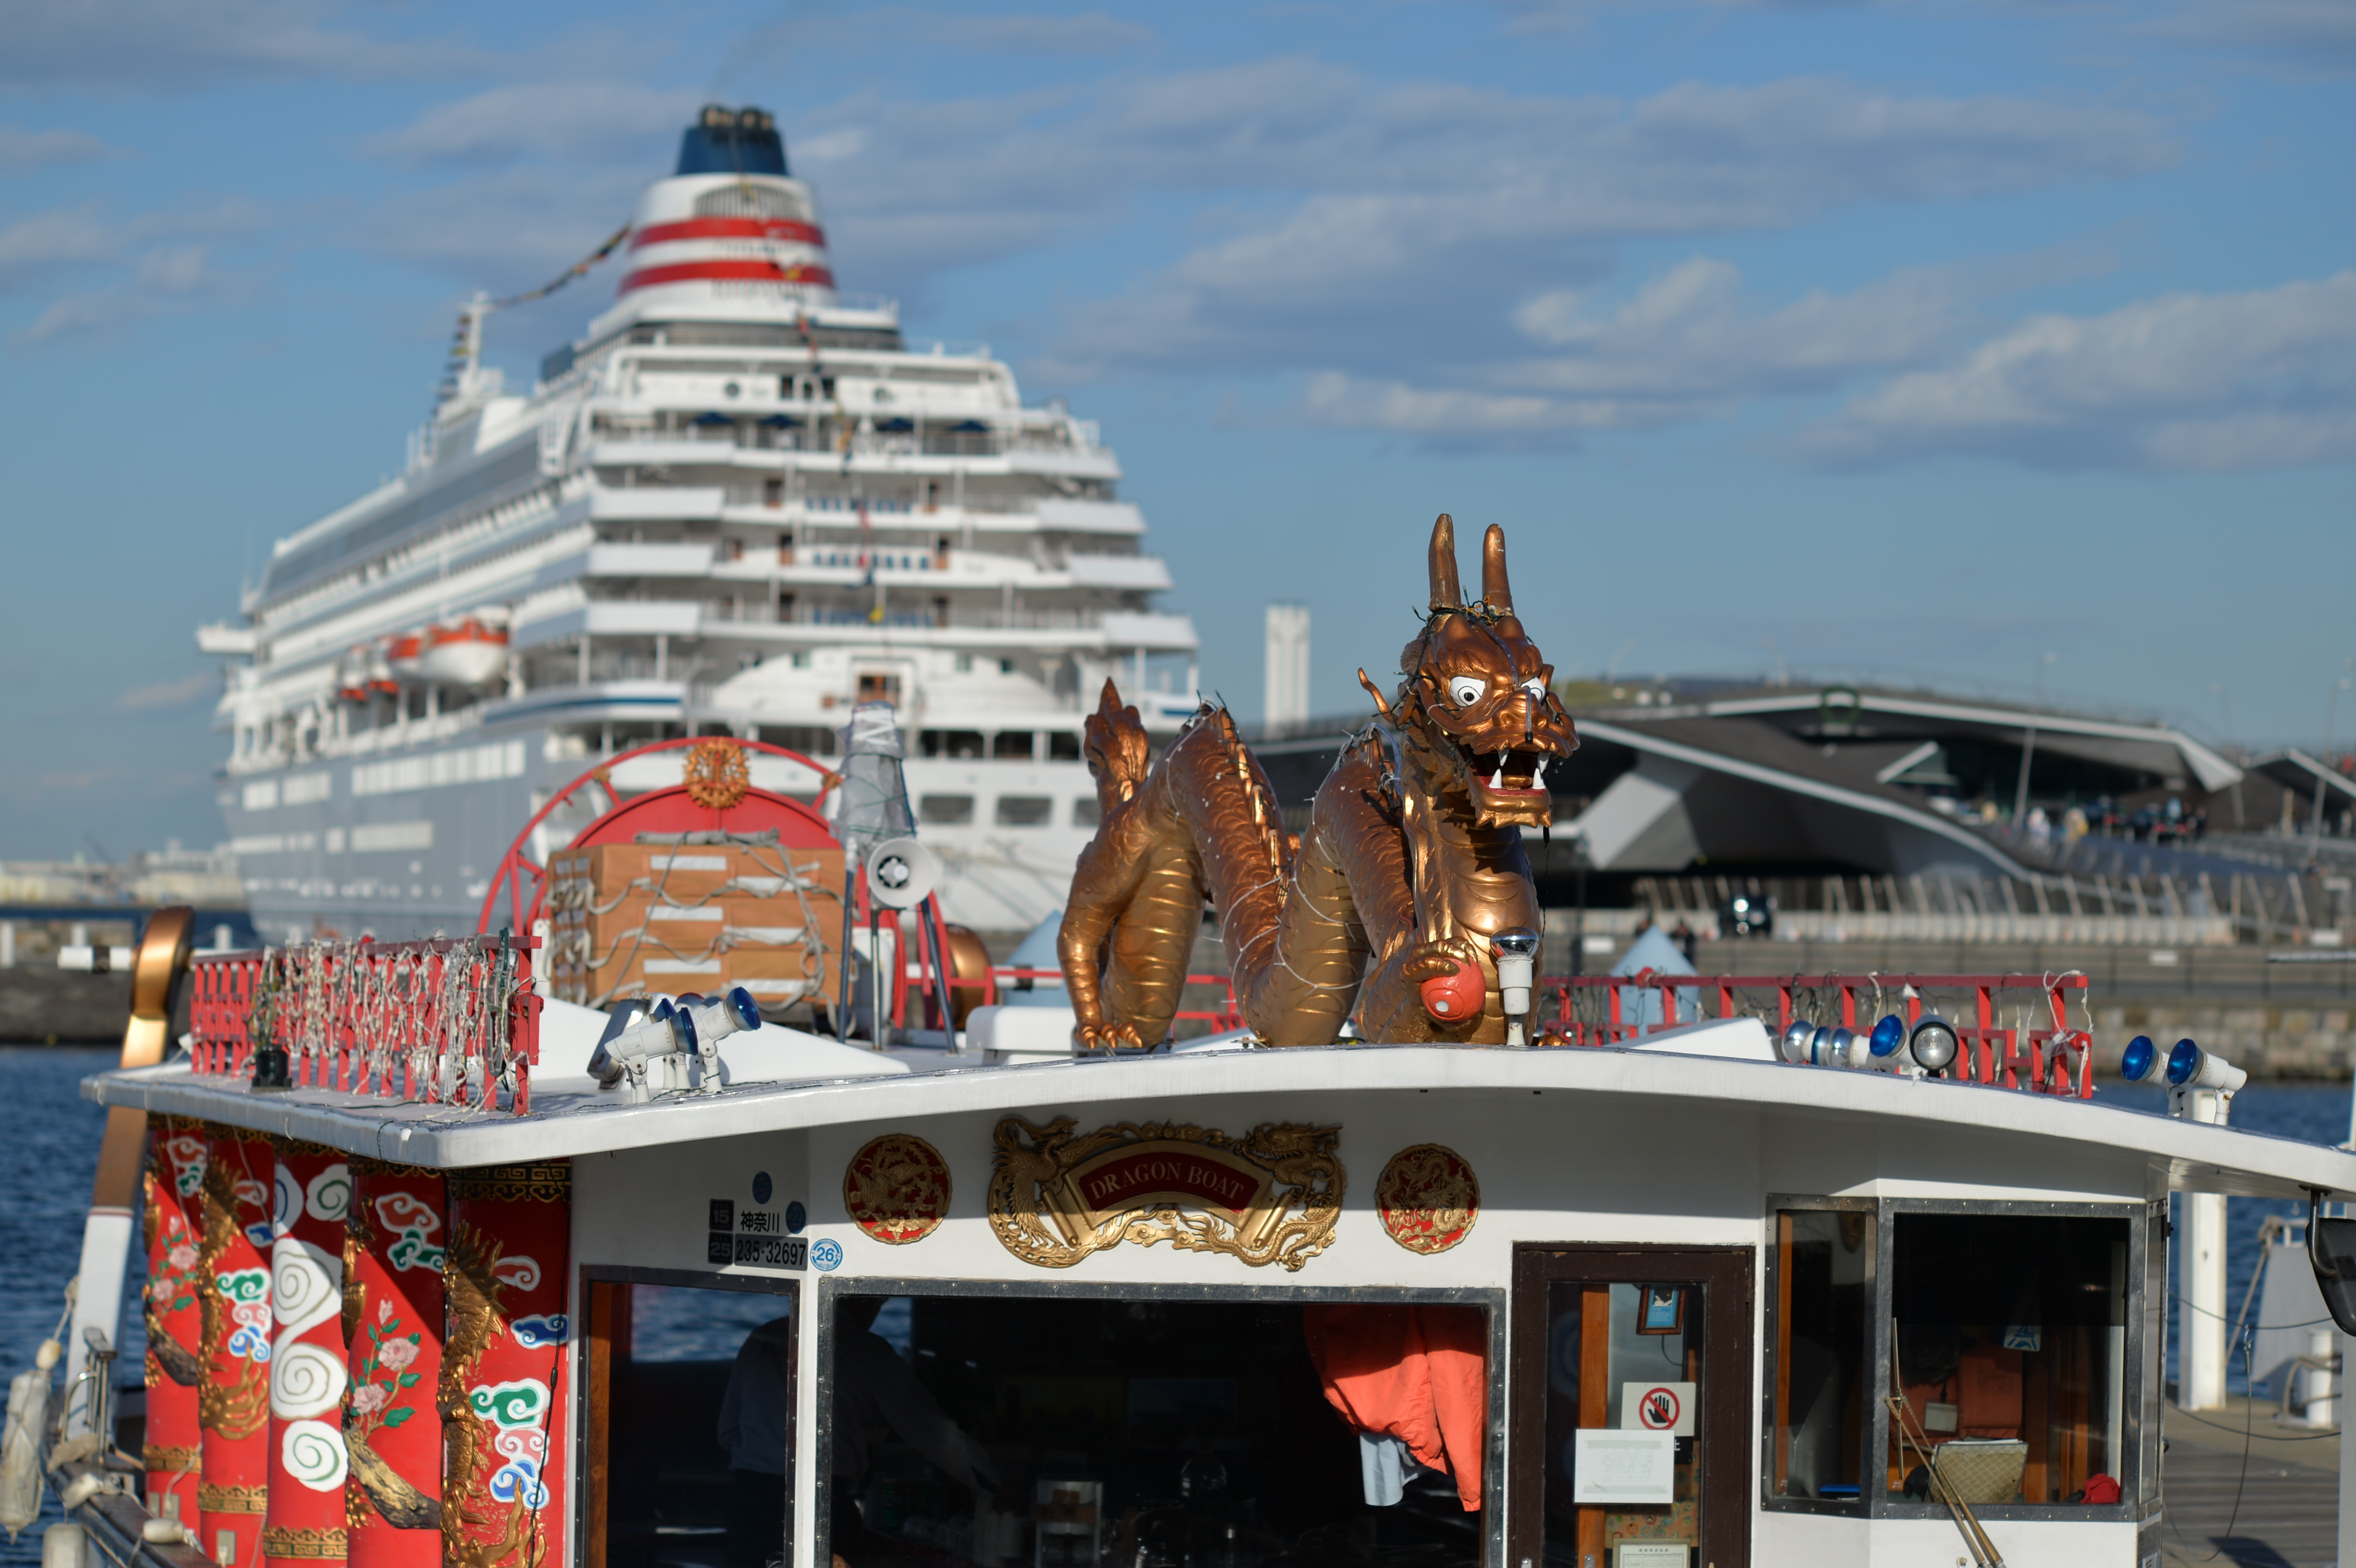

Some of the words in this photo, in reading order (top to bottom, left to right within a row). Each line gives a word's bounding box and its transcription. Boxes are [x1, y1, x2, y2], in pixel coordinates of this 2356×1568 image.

[1089, 1162, 1182, 1200] DRAGON
[1187, 1165, 1244, 1200] BOAT
[713, 1209, 730, 1224] 15
[741, 1210, 779, 1233] 神奈川
[789, 1209, 801, 1223] 22
[710, 1241, 731, 1258] 25
[816, 1247, 835, 1262] 26
